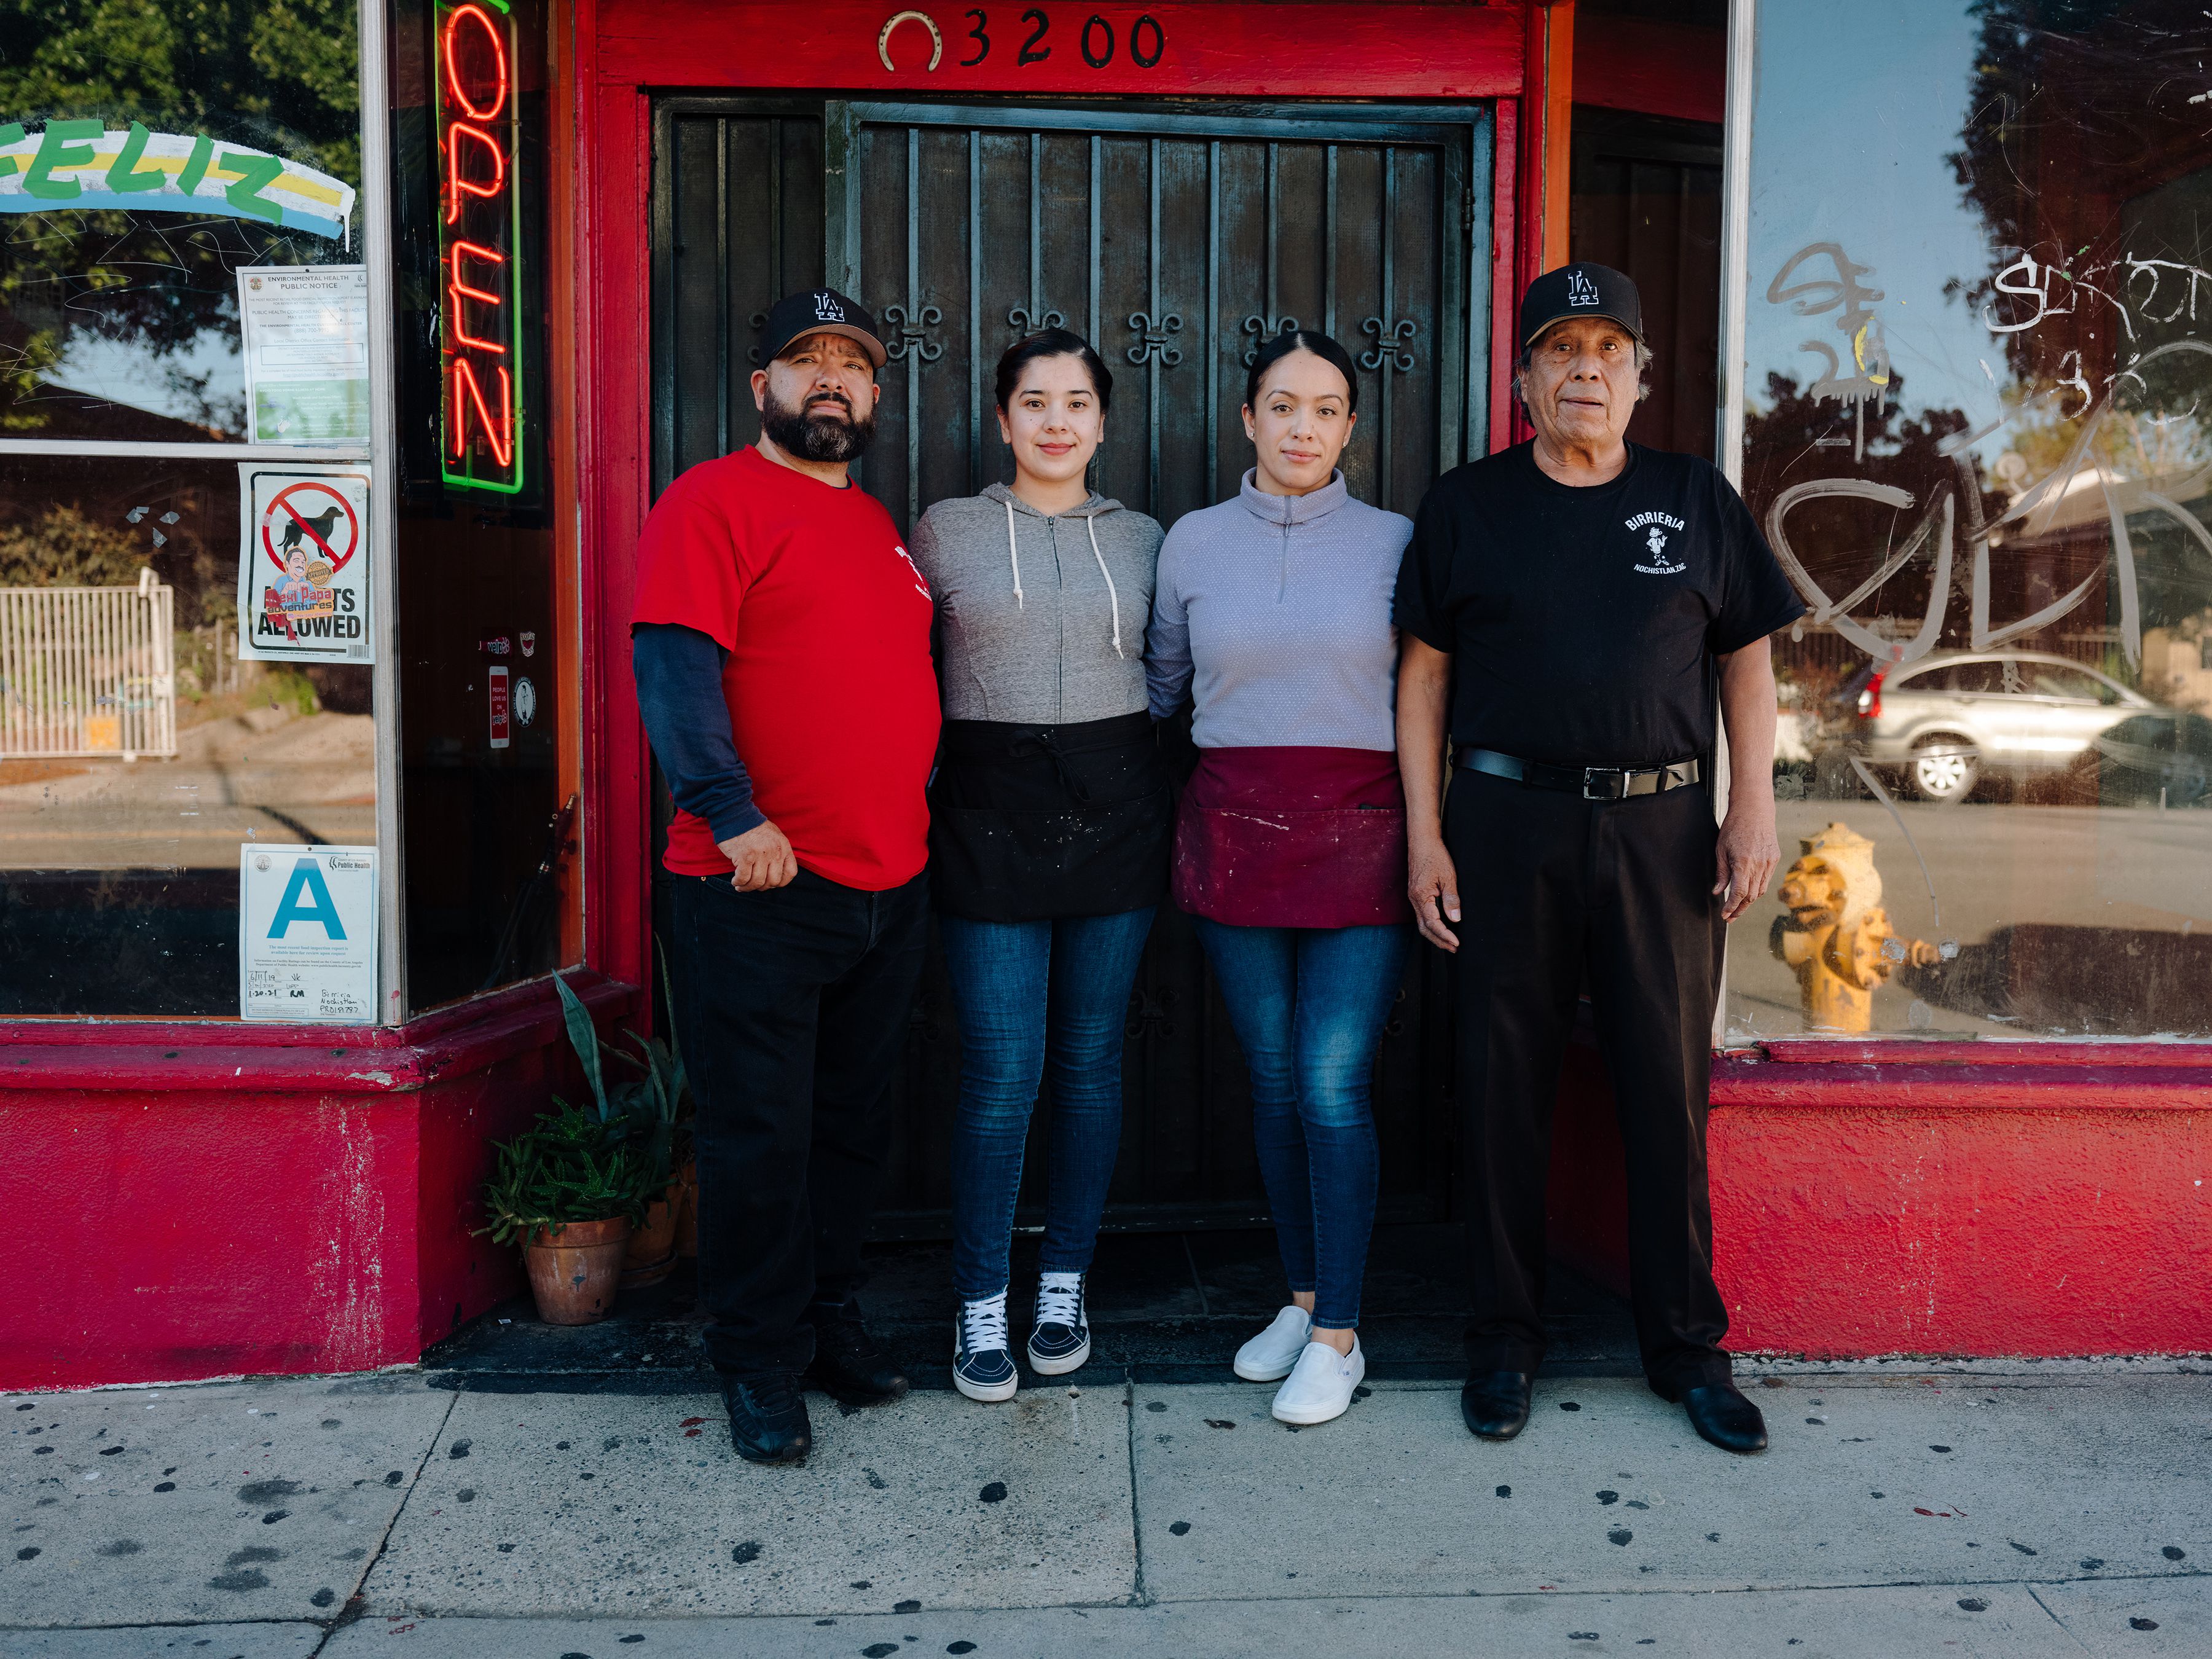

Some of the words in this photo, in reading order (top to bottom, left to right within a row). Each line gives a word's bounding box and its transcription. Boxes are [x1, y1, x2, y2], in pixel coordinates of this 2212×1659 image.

[960, 8, 1164, 69] 3200
[445, 3, 511, 468] OPEN
[1568, 270, 1599, 306] LA
[814, 292, 845, 321] LA
[1625, 511, 1685, 531] BIRRIERIA
[308, 569, 329, 579] APPROVED
[301, 586, 332, 603] Papa
[488, 639, 503, 654] yelp
[492, 713, 503, 726] yelp
[266, 858, 348, 940] A
